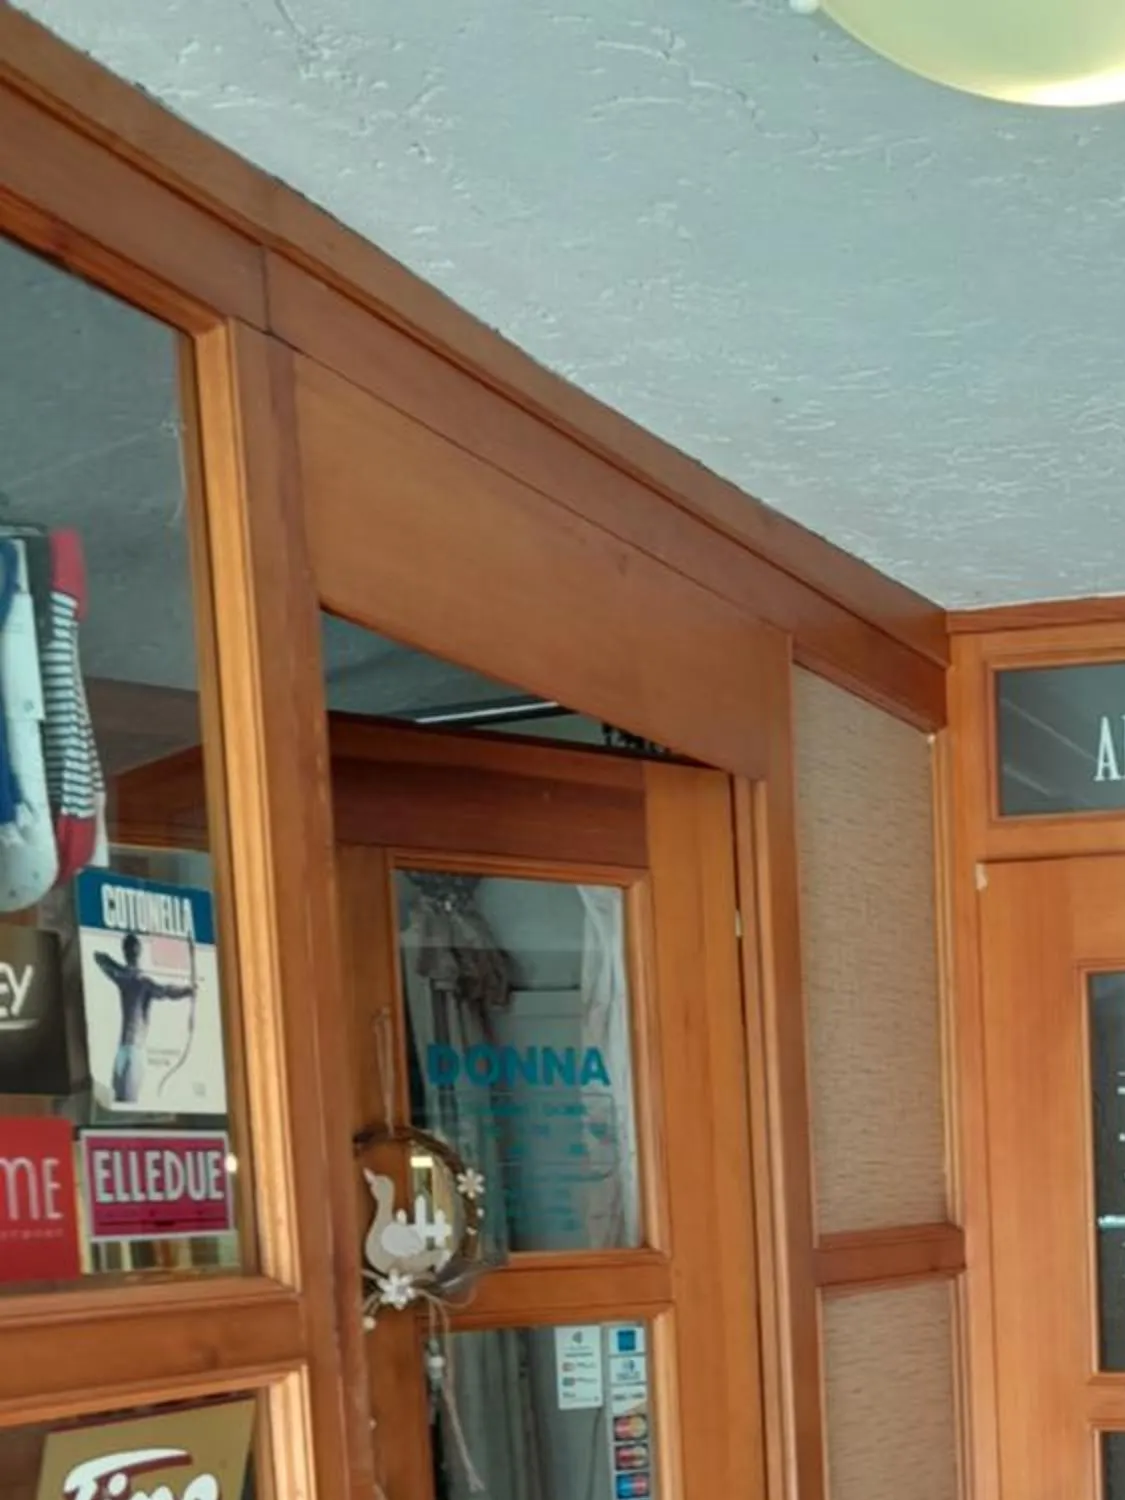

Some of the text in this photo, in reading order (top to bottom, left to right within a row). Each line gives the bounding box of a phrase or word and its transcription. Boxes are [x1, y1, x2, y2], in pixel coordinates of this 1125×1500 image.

[101, 884, 194, 938] COTONELLA
[426, 1044, 612, 1087] DONNA
[93, 1147, 226, 1204] ELLEDUE
